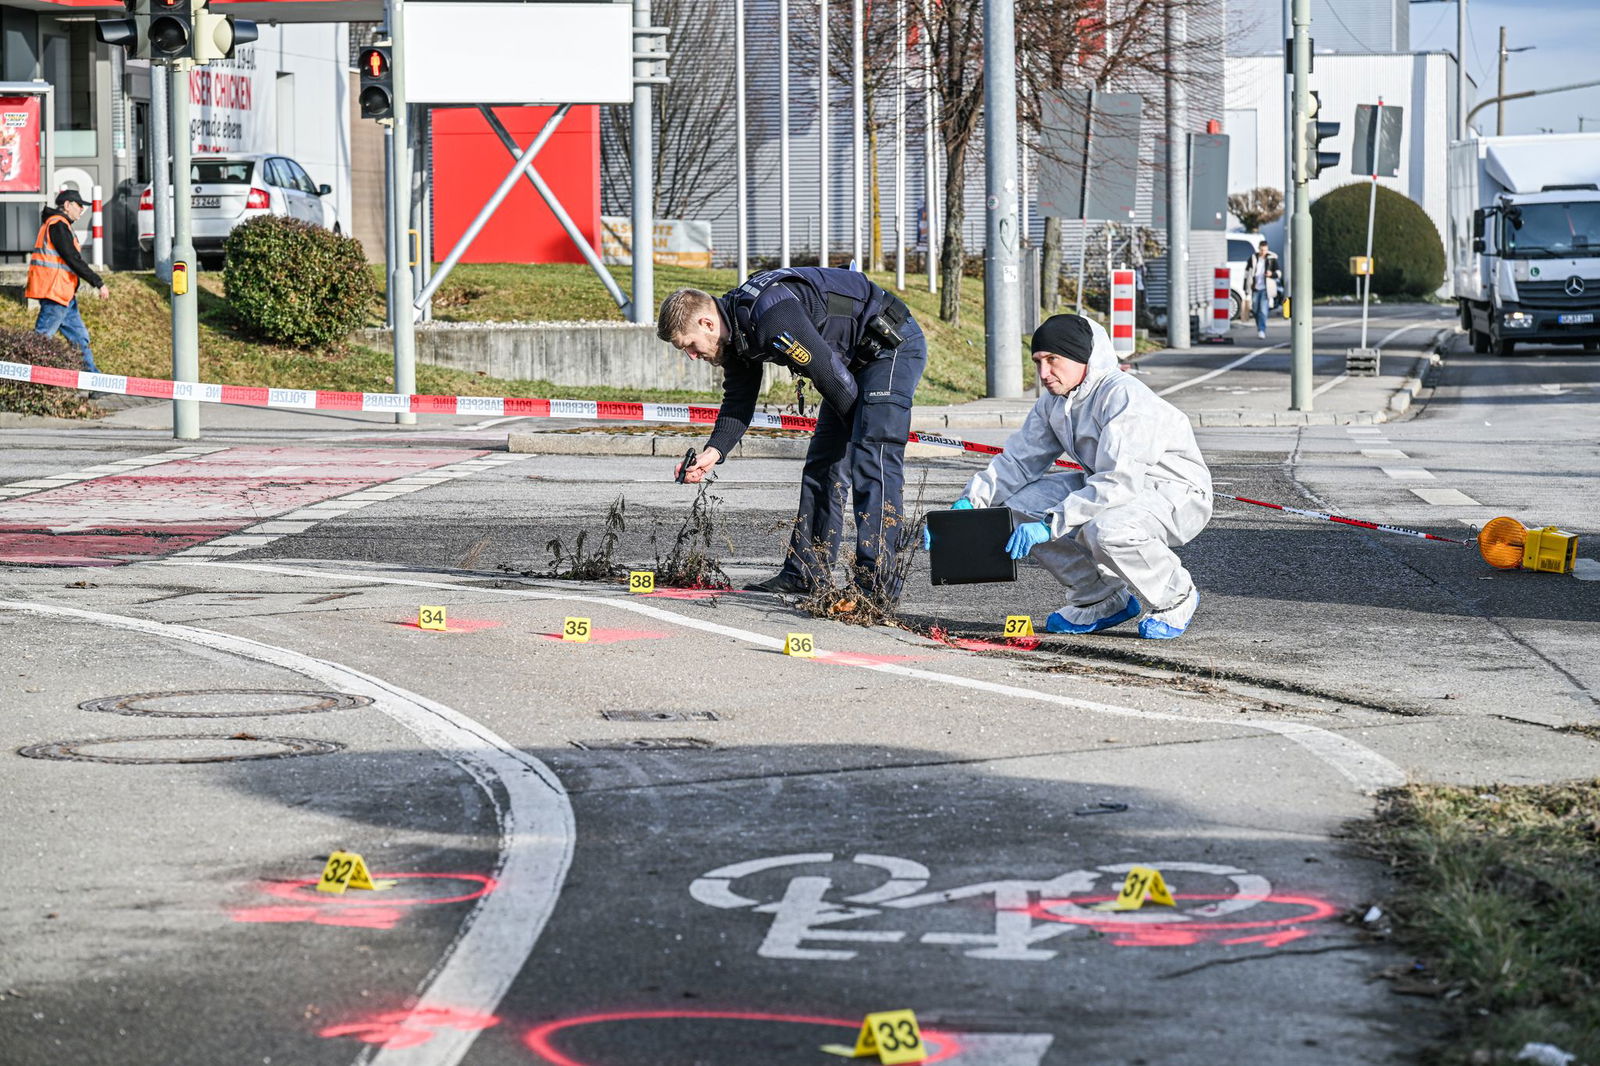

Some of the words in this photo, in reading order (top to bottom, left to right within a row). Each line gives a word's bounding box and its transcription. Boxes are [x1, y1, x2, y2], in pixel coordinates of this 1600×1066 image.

[189, 69, 212, 107] NSER
[214, 72, 252, 110] CHICKEN
[190, 112, 221, 141] gerade
[223, 115, 242, 139] eben
[632, 575, 652, 588] 38
[422, 609, 444, 624] 34
[1006, 619, 1027, 633] 37
[565, 620, 588, 636] 35
[790, 637, 812, 652] 36
[324, 858, 353, 884] 32
[1123, 873, 1149, 900] 31
[878, 1020, 919, 1052] 33
